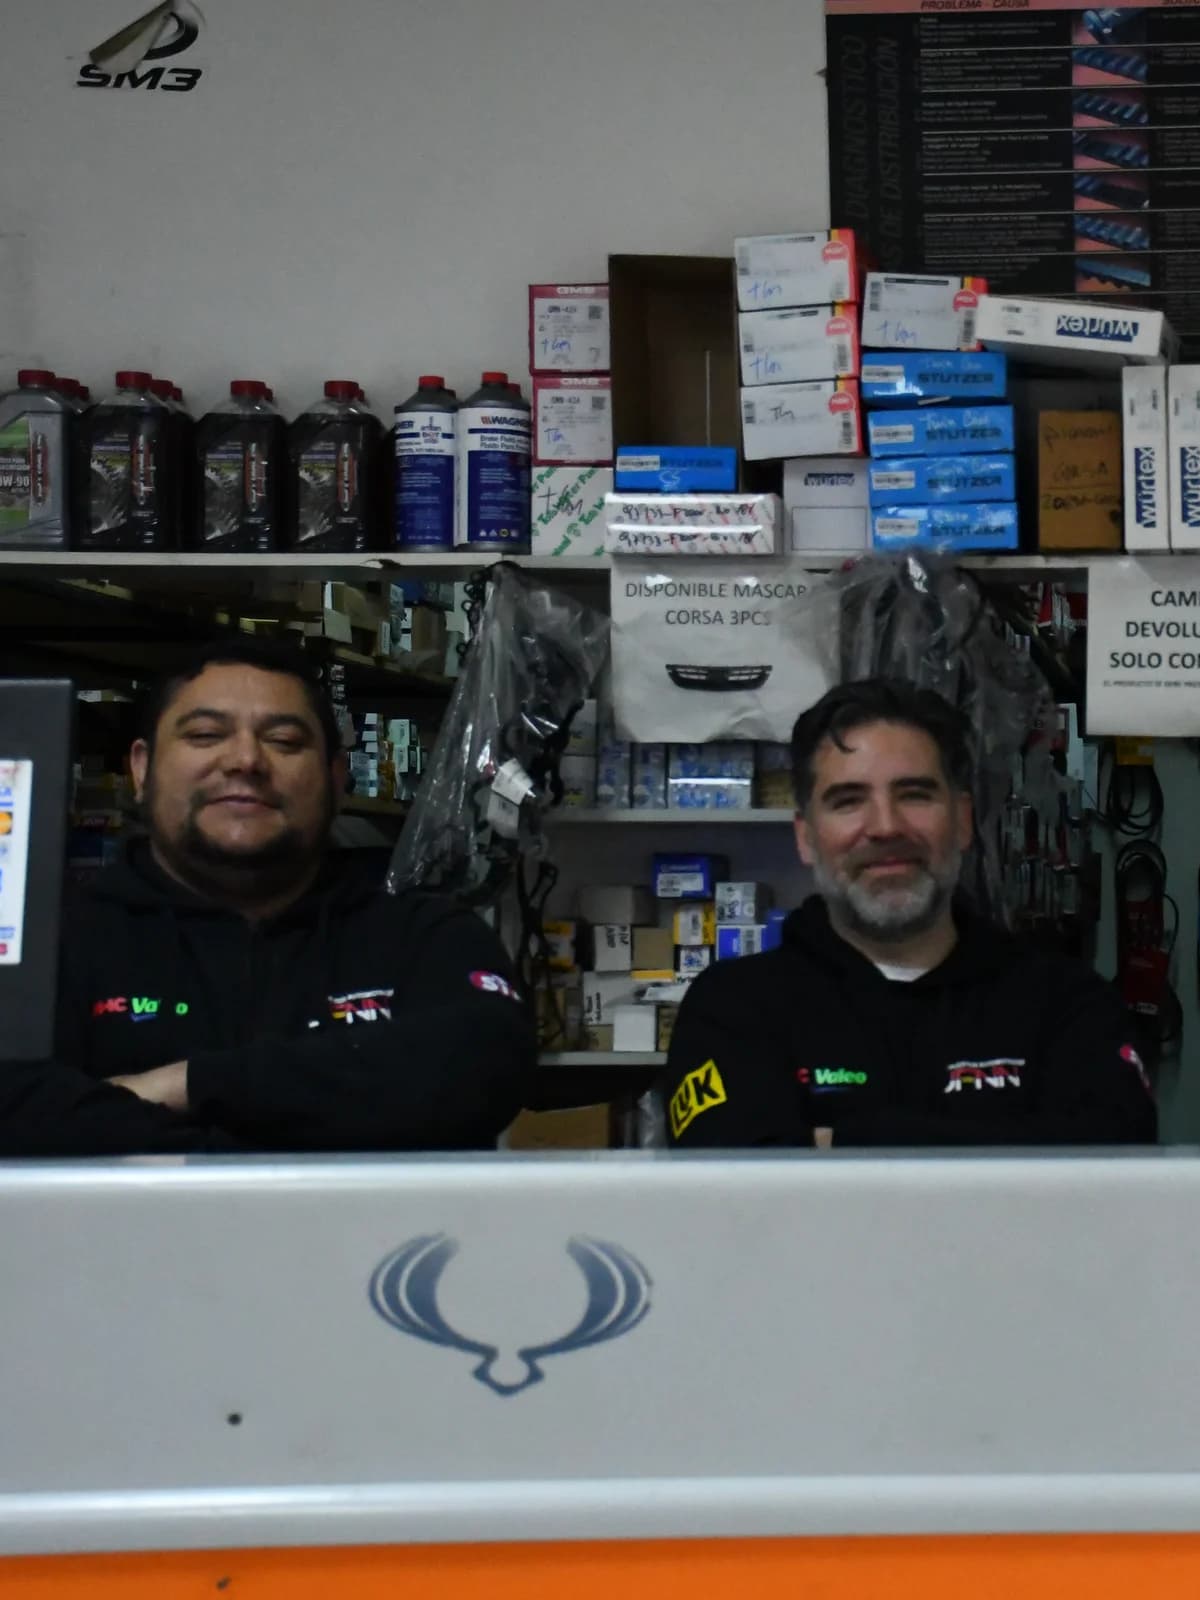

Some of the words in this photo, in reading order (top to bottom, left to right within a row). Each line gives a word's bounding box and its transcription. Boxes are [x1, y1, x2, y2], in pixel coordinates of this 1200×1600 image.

[76, 63, 202, 92] SM3
[625, 582, 728, 599] DISPONIBLE
[665, 610, 724, 625] CORSA
[729, 611, 773, 626] 3PCS
[1110, 652, 1162, 669] SOLO
[131, 995, 190, 1014] Vao
[814, 1067, 868, 1085] Valeo
